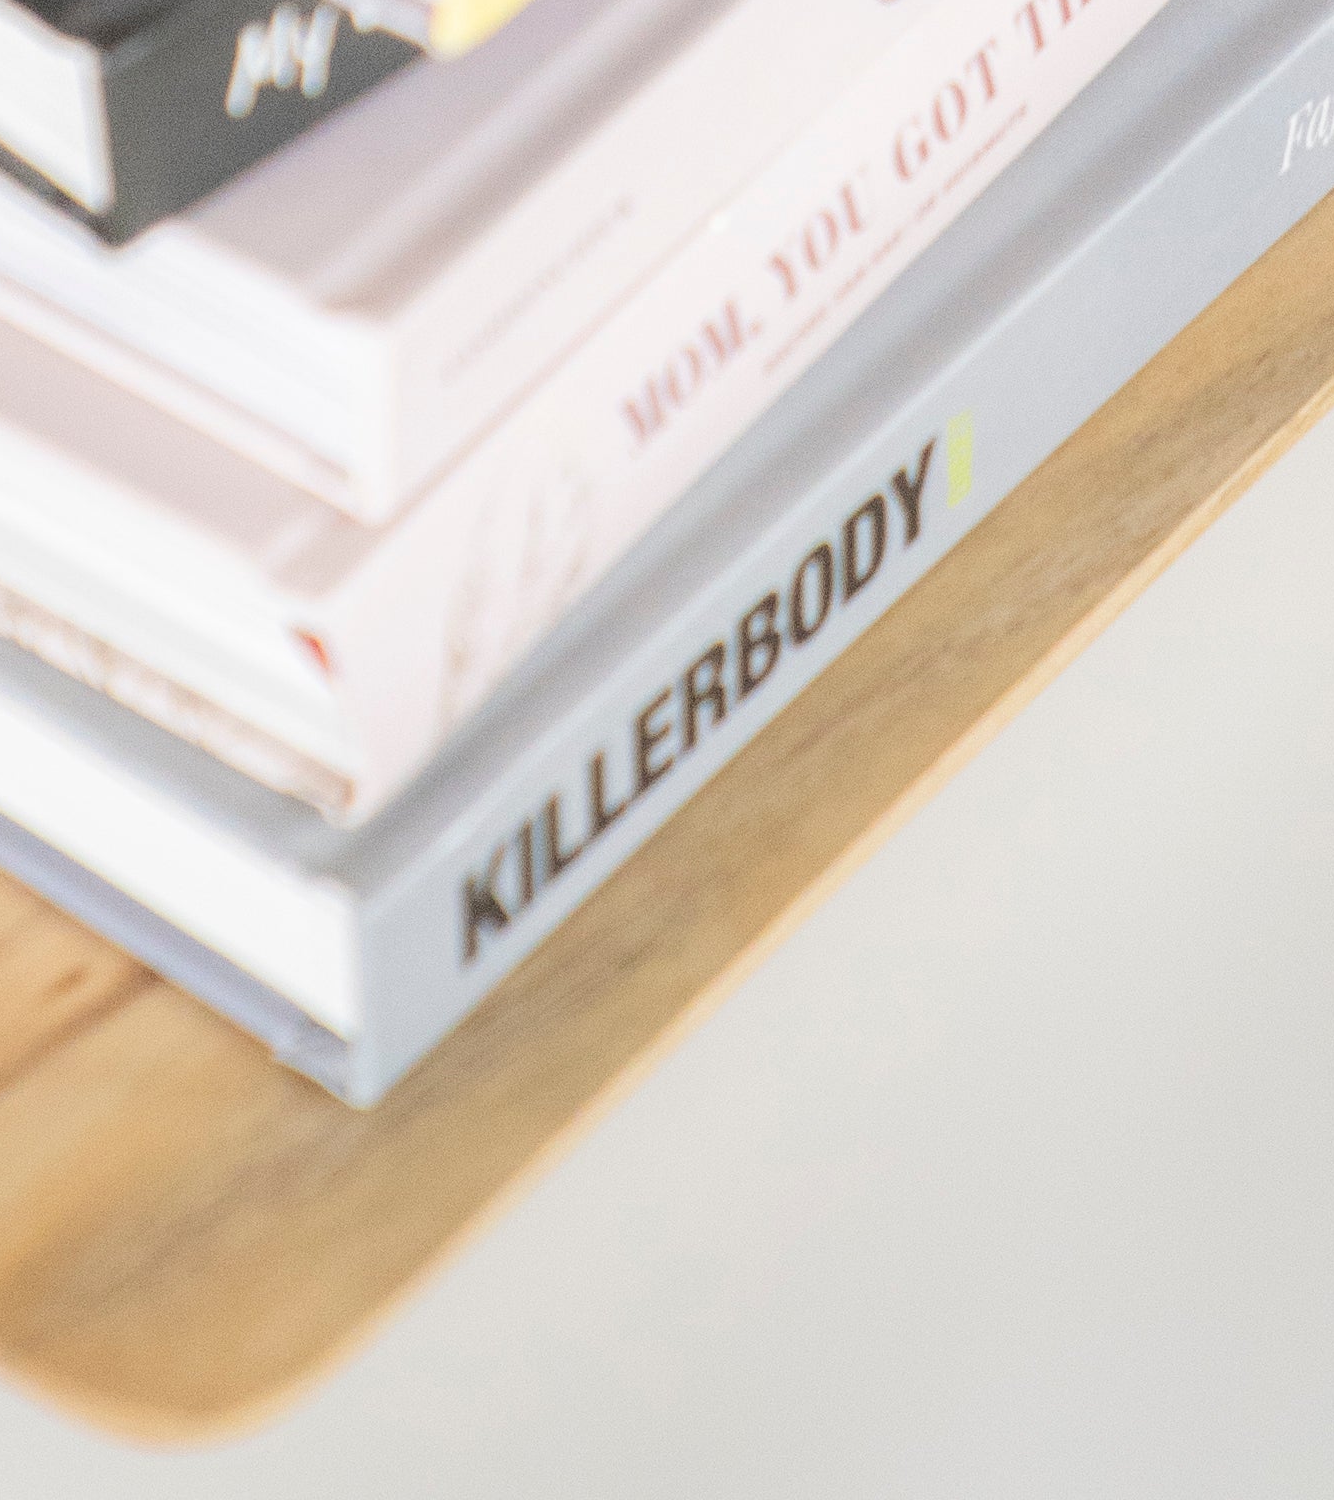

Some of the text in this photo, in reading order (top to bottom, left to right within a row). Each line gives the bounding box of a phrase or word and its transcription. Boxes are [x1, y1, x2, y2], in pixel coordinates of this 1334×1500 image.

[766, 164, 869, 302] YOU
[889, 39, 1004, 186] GOT
[458, 436, 937, 966] KILLERBODY
